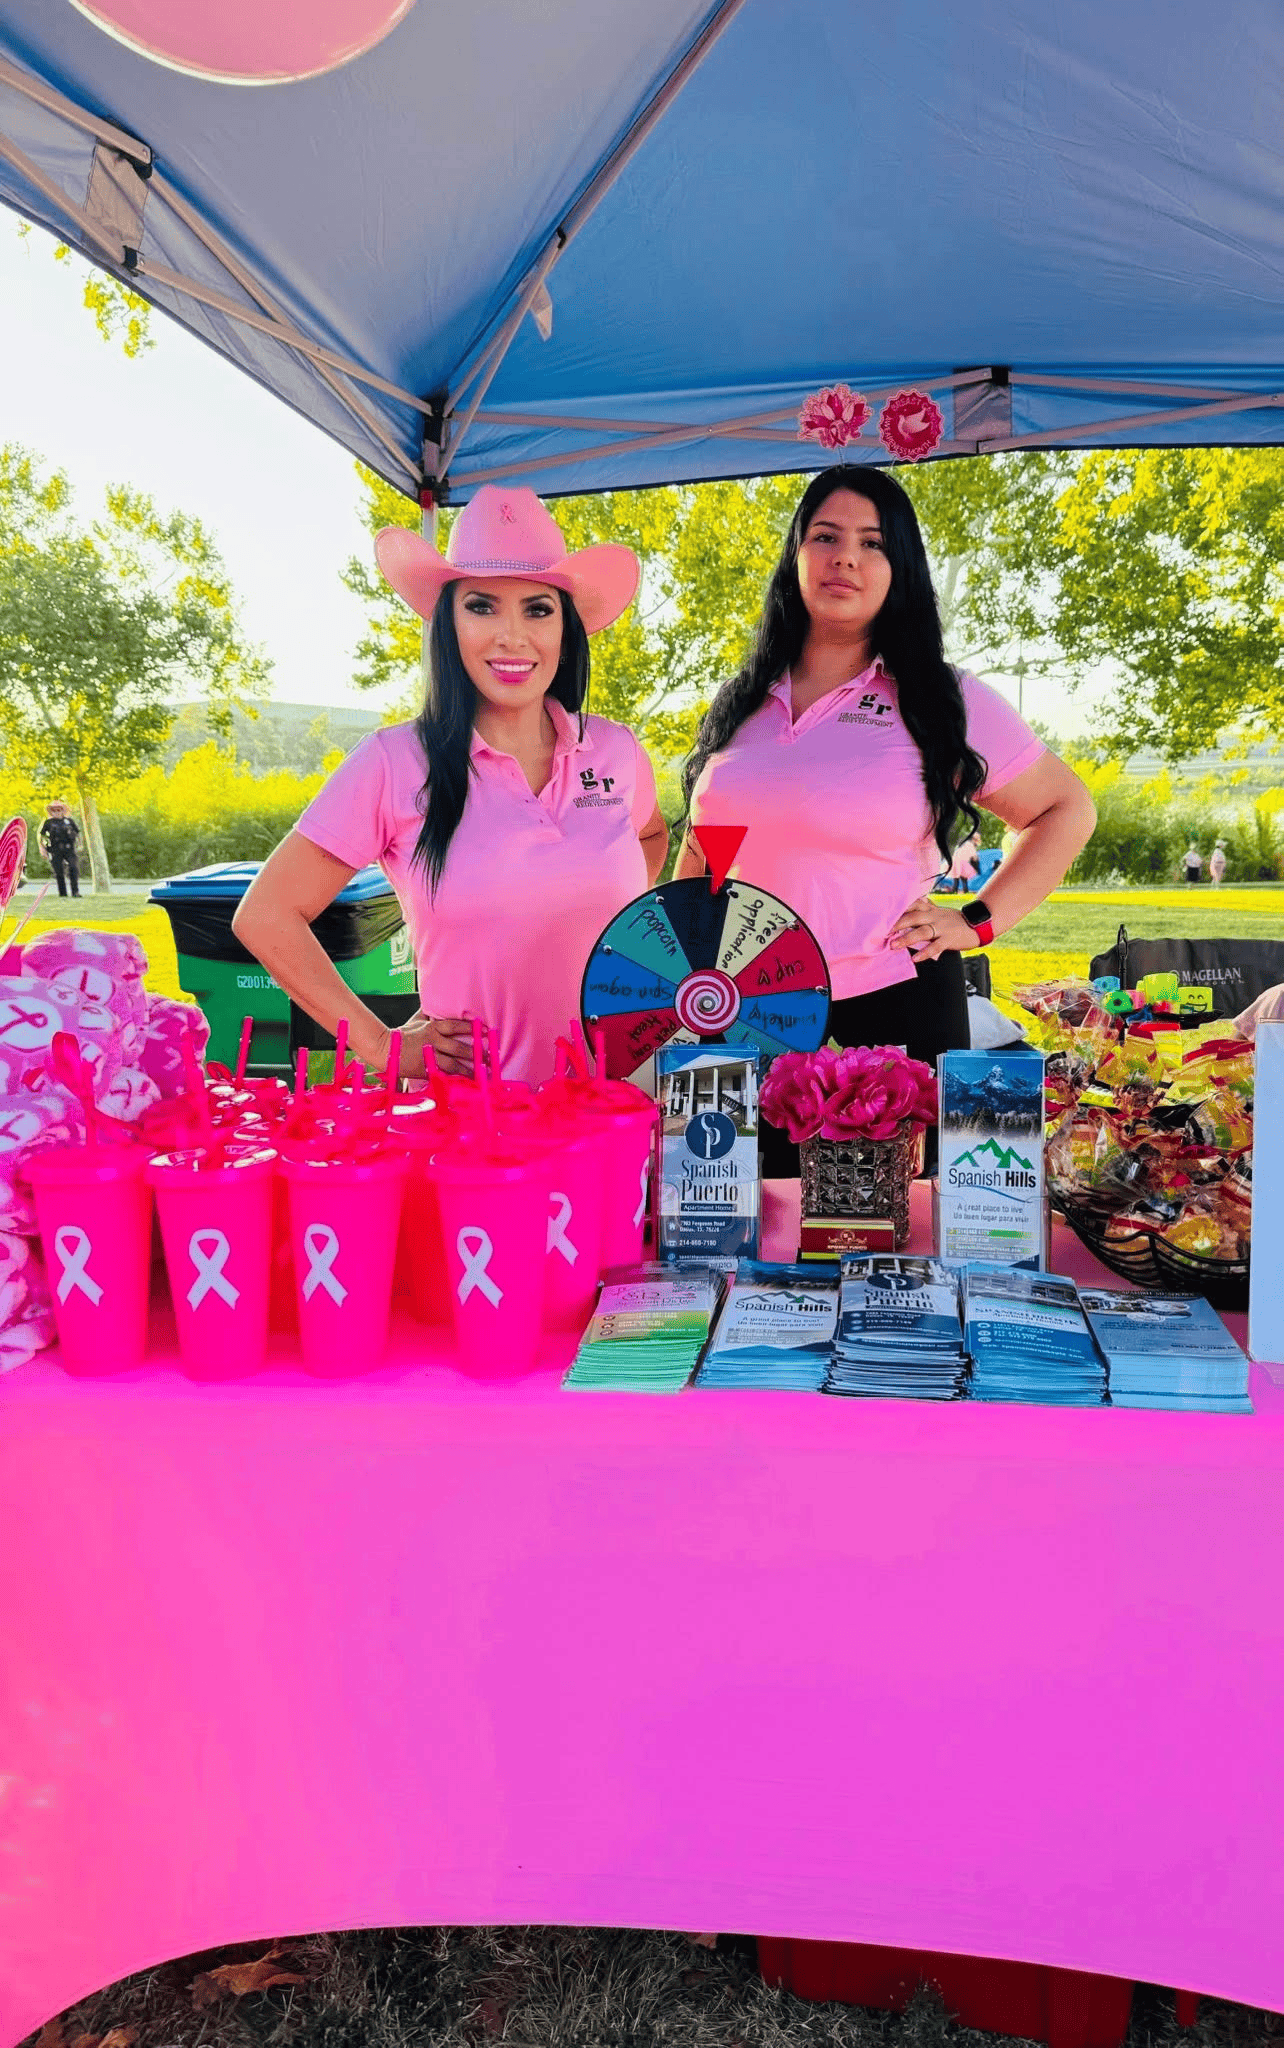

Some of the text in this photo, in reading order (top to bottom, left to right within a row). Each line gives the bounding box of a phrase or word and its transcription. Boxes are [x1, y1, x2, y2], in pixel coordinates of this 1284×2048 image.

[627, 909, 677, 957] popcorn
[721, 899, 764, 969] application
[756, 912, 787, 944] free
[775, 957, 804, 983] cup
[1182, 967, 1241, 982] MAGELLAN
[589, 976, 673, 1000] spin again
[681, 1160, 738, 1180] Spanish
[949, 1168, 1037, 1188] Spanish Hills
[681, 1179, 738, 1201] Puerto
[683, 1204, 713, 1212] Apartment
[983, 1205, 1001, 1213] place
[981, 1214, 997, 1222] lugar
[999, 1215, 1013, 1223] para
[864, 1289, 930, 1299] Spanish
[866, 1296, 933, 1308] Puerto
[735, 1301, 832, 1312] Spanish Hills
